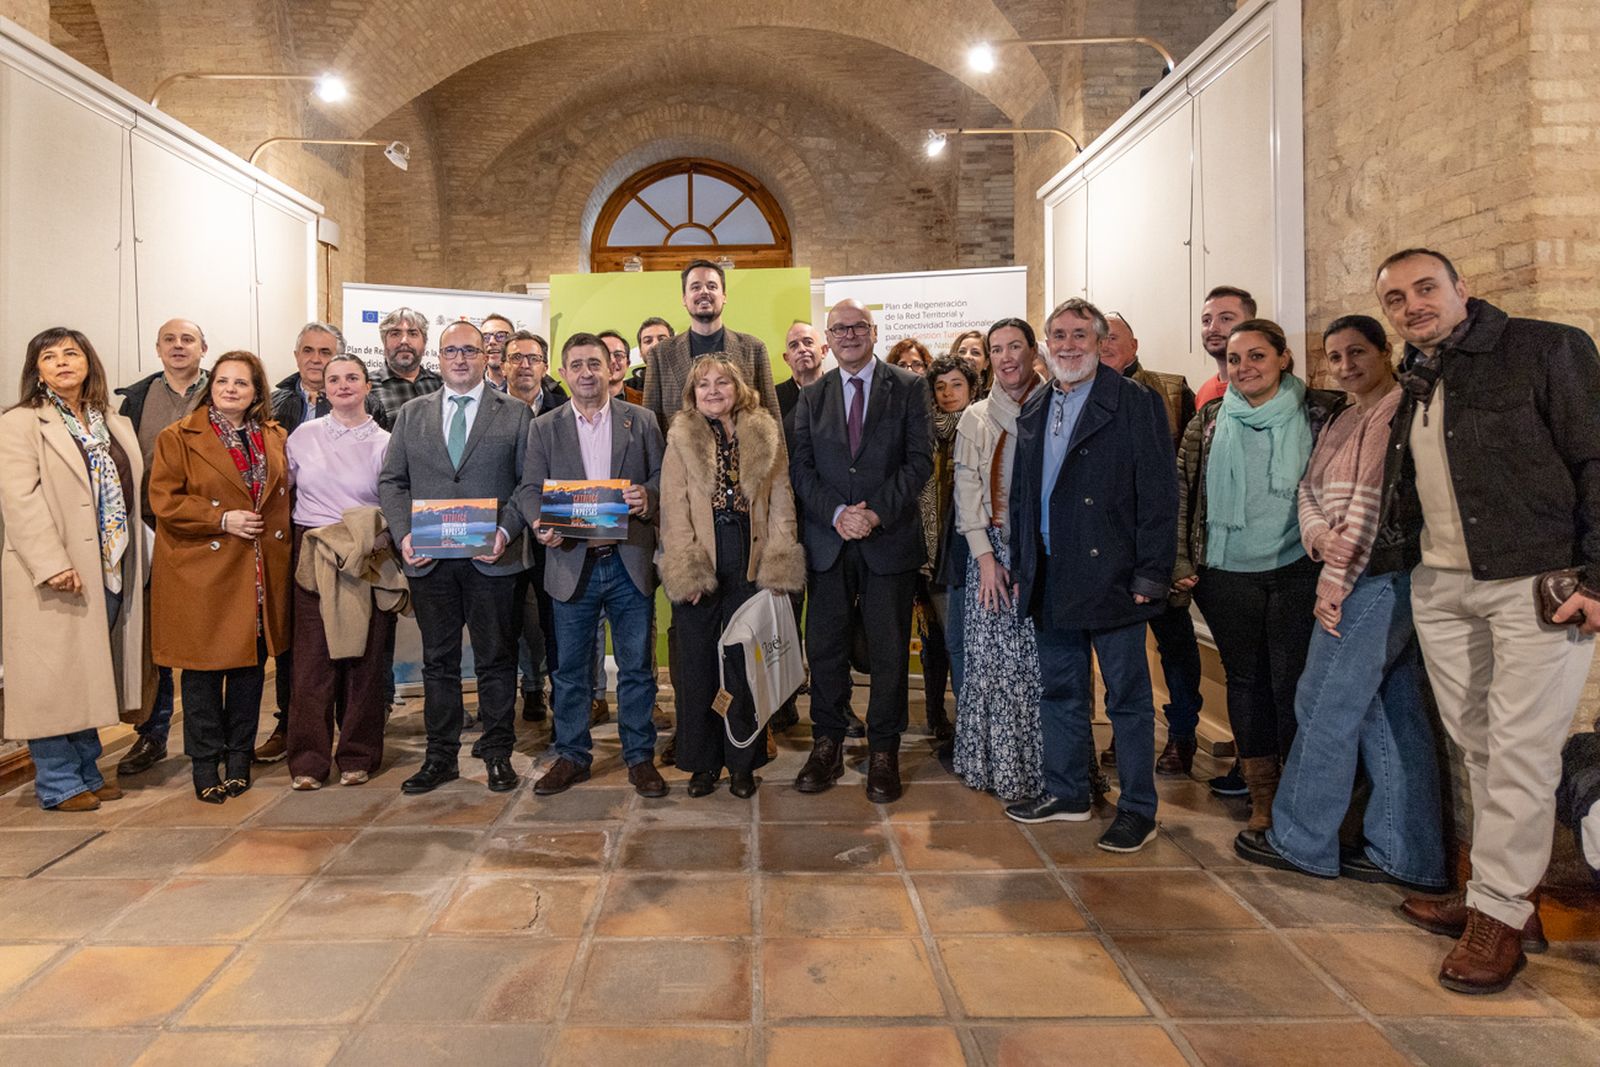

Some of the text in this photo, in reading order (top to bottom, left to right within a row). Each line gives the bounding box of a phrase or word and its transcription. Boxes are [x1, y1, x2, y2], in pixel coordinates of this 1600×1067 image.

[914, 300, 967, 310] Regeneración
[897, 312, 904, 320] la
[922, 310, 957, 318] Territorial
[893, 321, 943, 330] Conectividad
[346, 346, 362, 354] Plan
[364, 346, 373, 354] de
